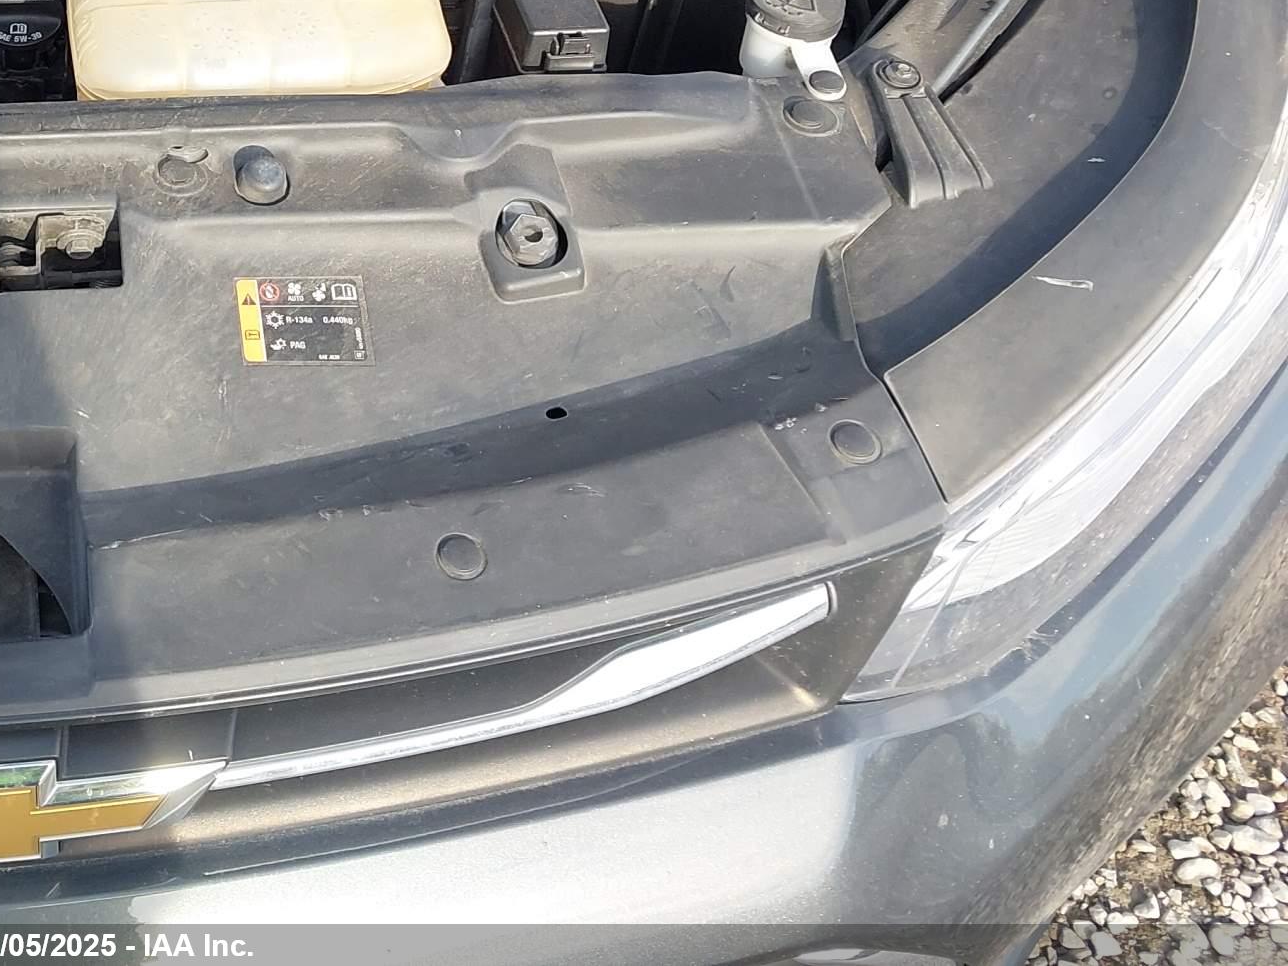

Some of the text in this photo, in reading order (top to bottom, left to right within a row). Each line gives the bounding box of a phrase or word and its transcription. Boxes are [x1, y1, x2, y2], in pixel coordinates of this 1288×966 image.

[14, 31, 42, 43] 5W-30
[285, 315, 313, 324] R-134a
[289, 341, 306, 350] PAG
